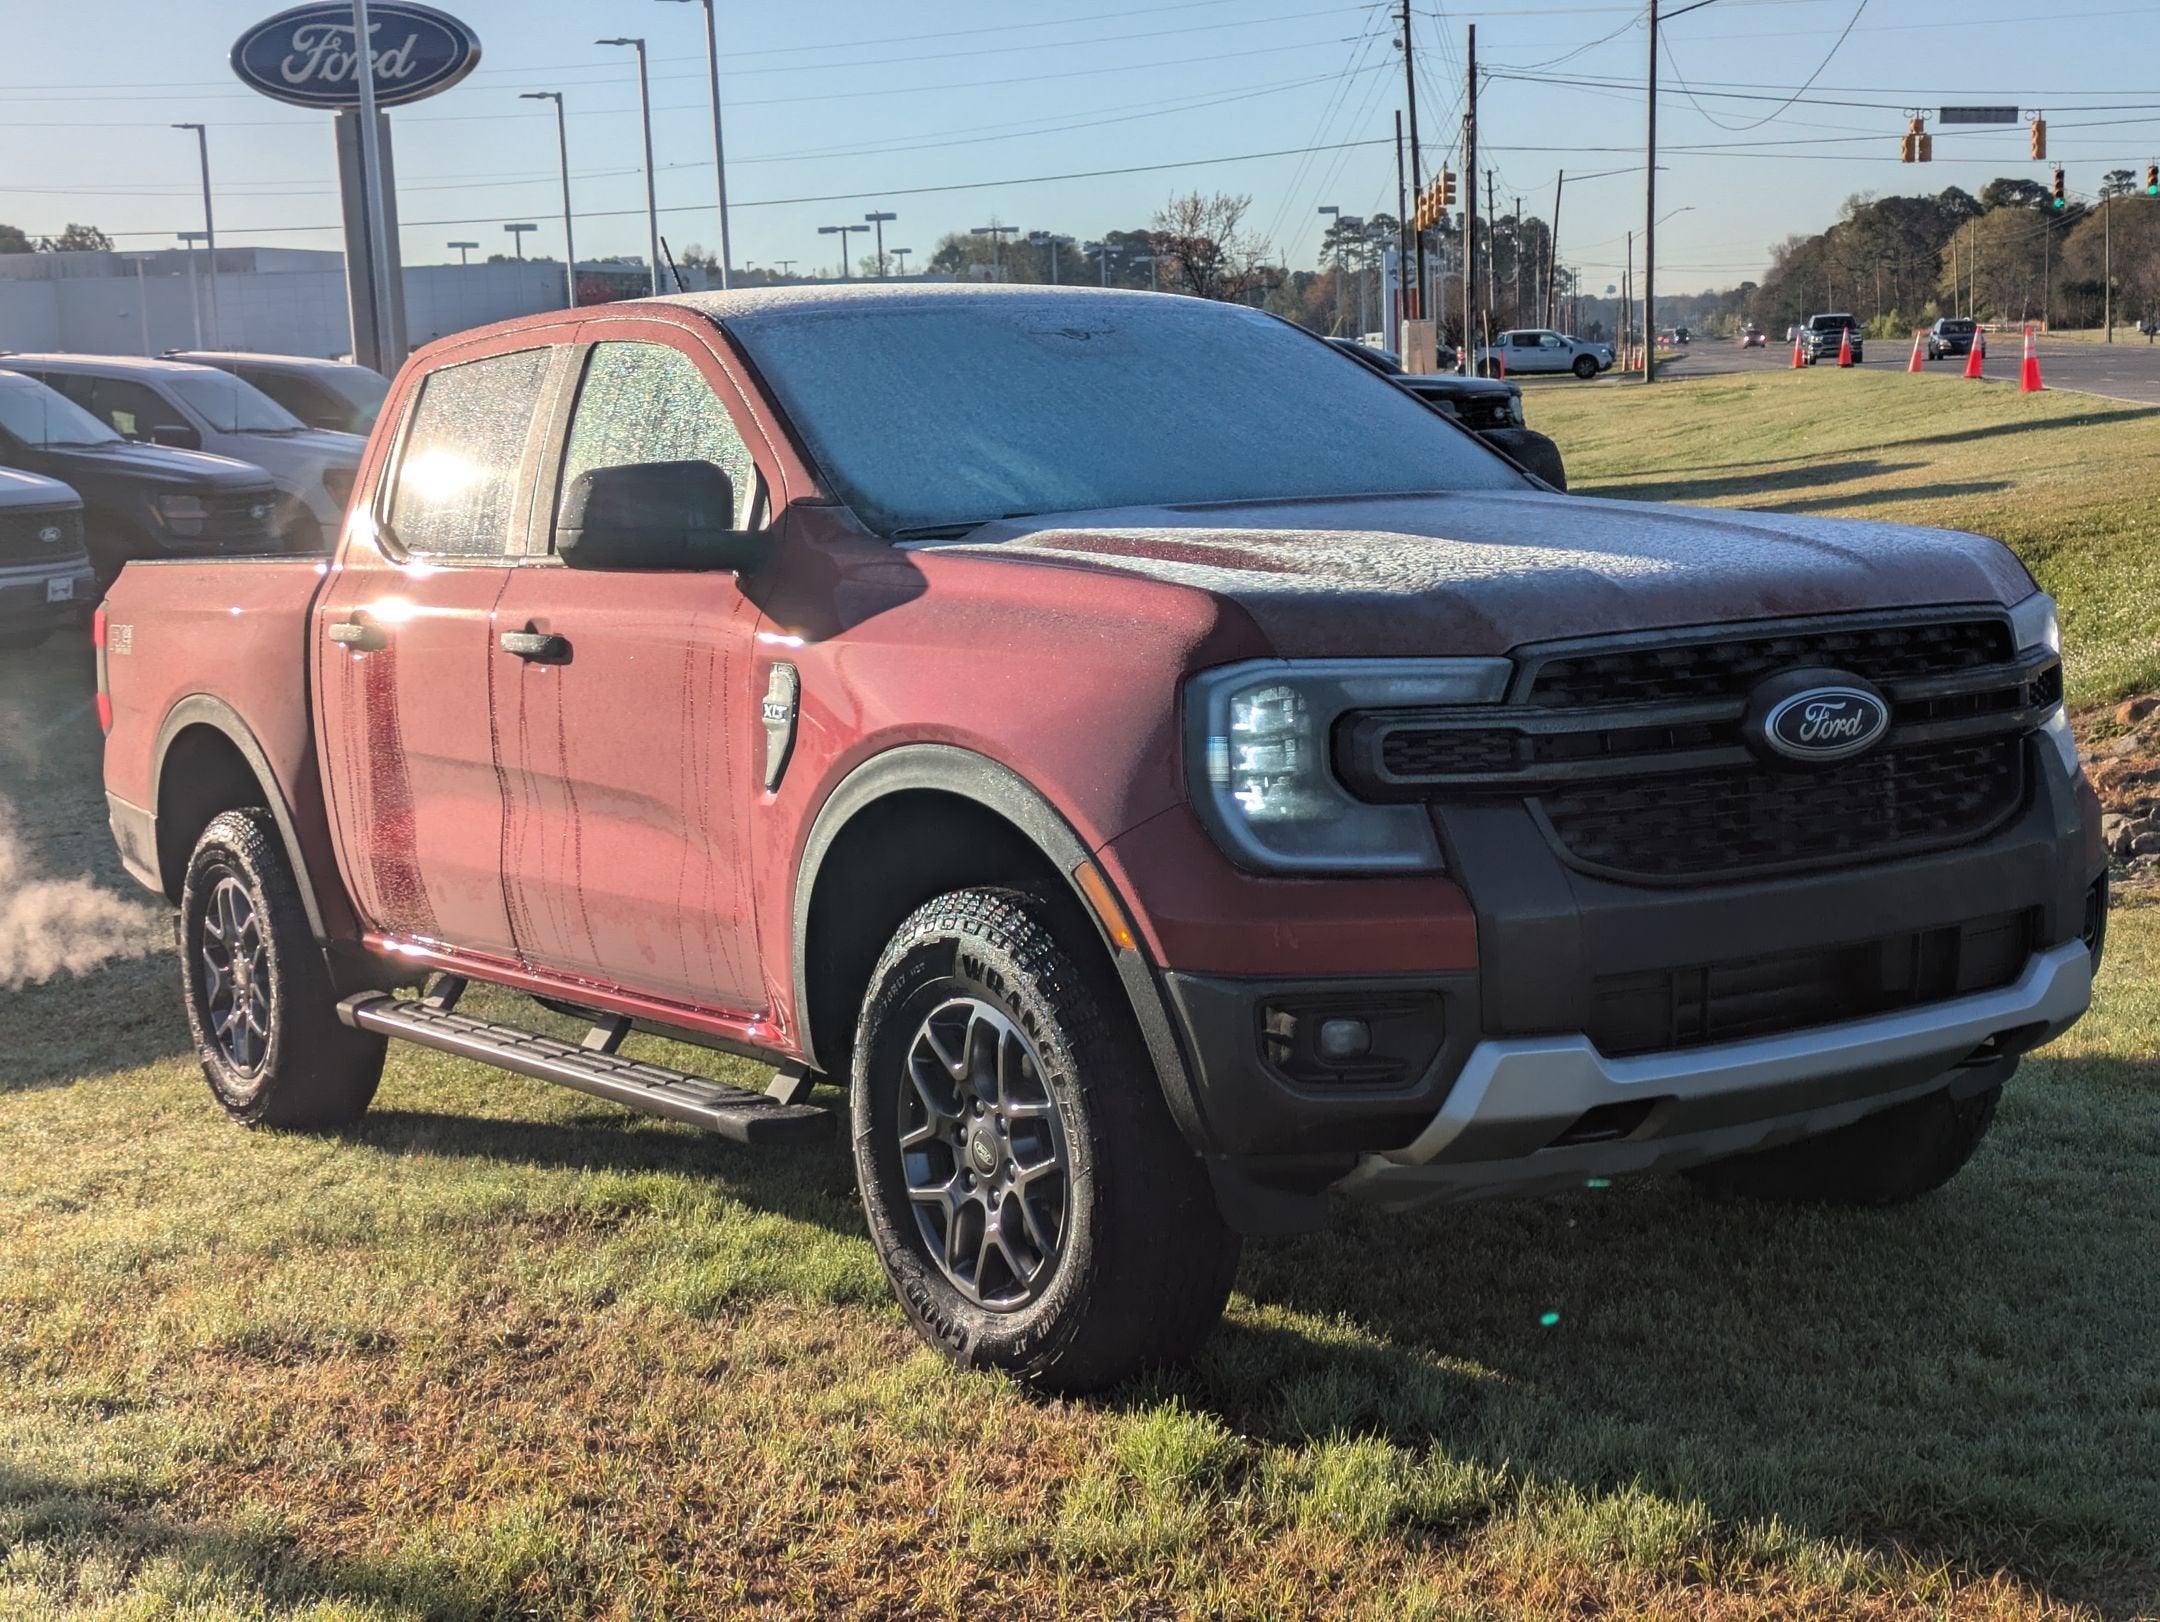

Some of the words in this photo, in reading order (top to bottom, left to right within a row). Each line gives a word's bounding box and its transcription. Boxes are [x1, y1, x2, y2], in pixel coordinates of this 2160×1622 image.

[281, 23, 419, 84] Ford
[763, 703, 788, 720] XLT
[1800, 702, 1863, 741] Ford
[962, 953, 1082, 1163] WRANGLER
